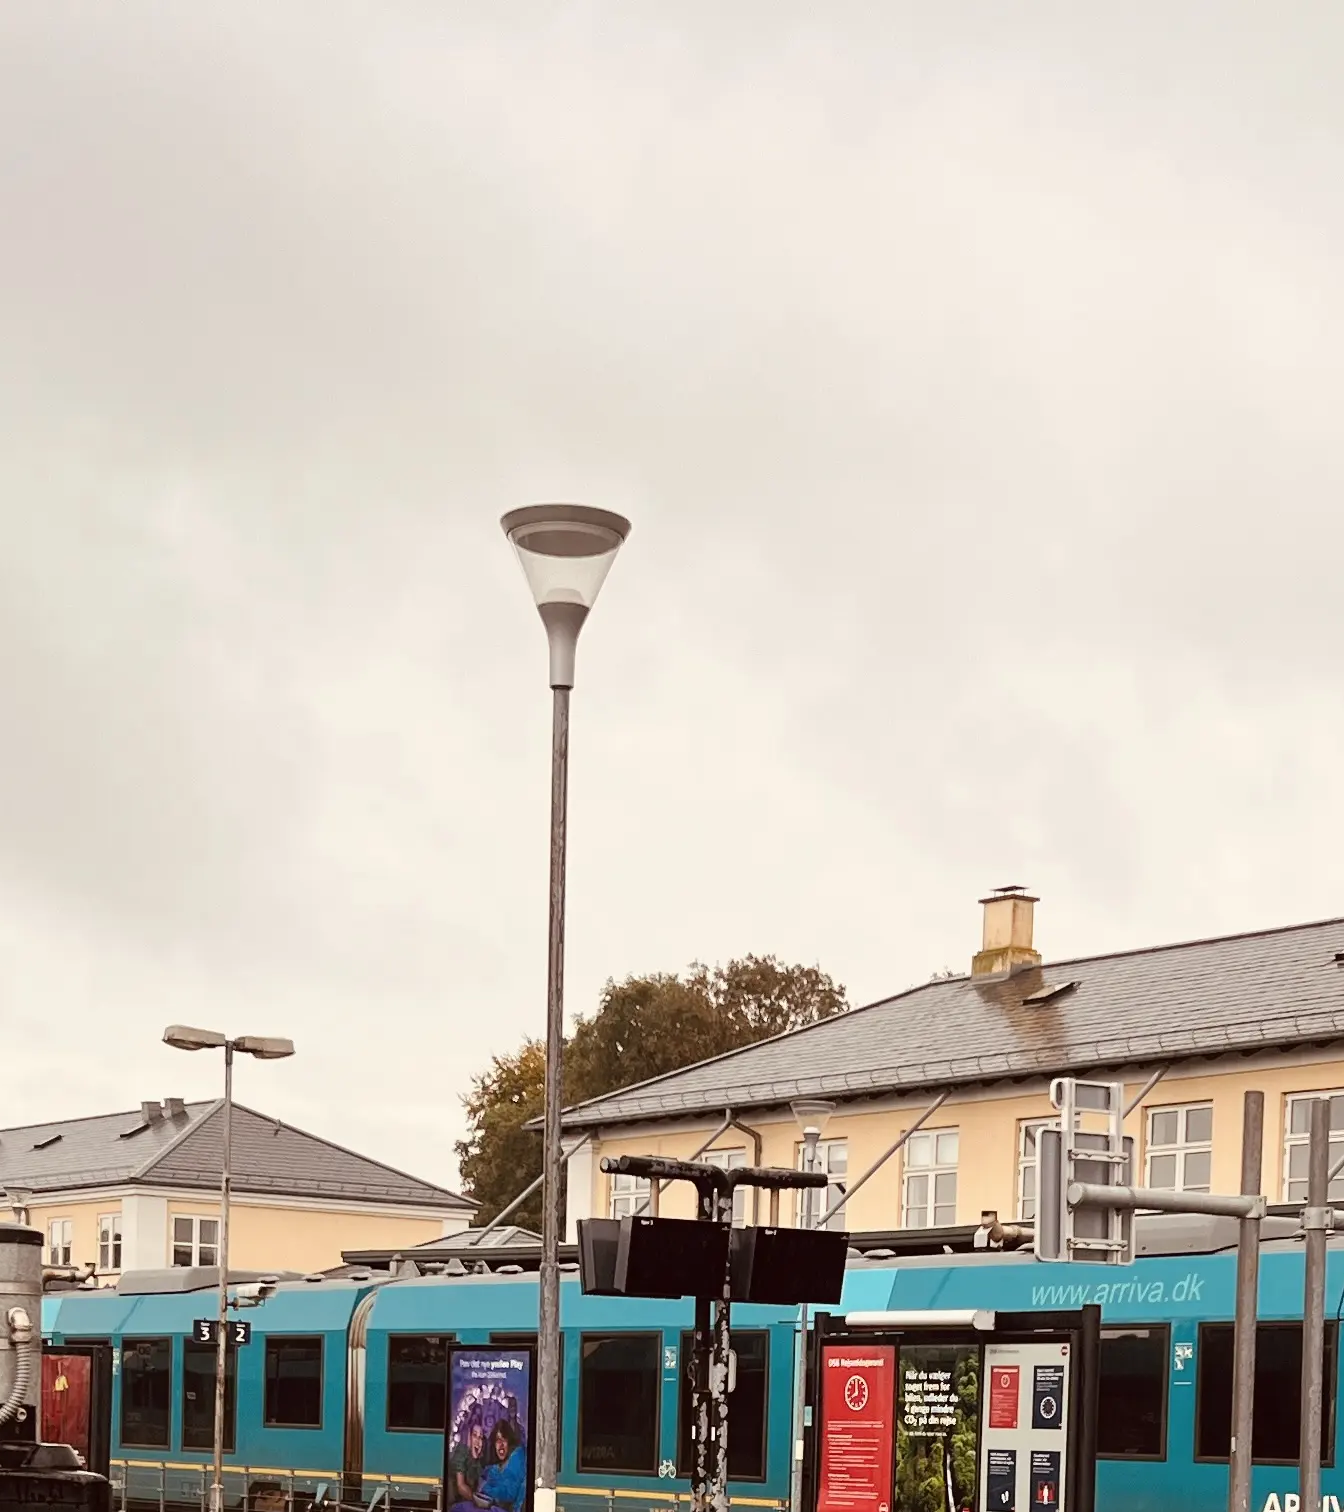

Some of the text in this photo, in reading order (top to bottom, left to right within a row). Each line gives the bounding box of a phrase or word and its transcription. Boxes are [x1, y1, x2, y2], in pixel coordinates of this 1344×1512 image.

[1031, 1273, 1205, 1306] www.arriva.dk
[200, 1326, 210, 1341] 3
[235, 1327, 246, 1342] 2
